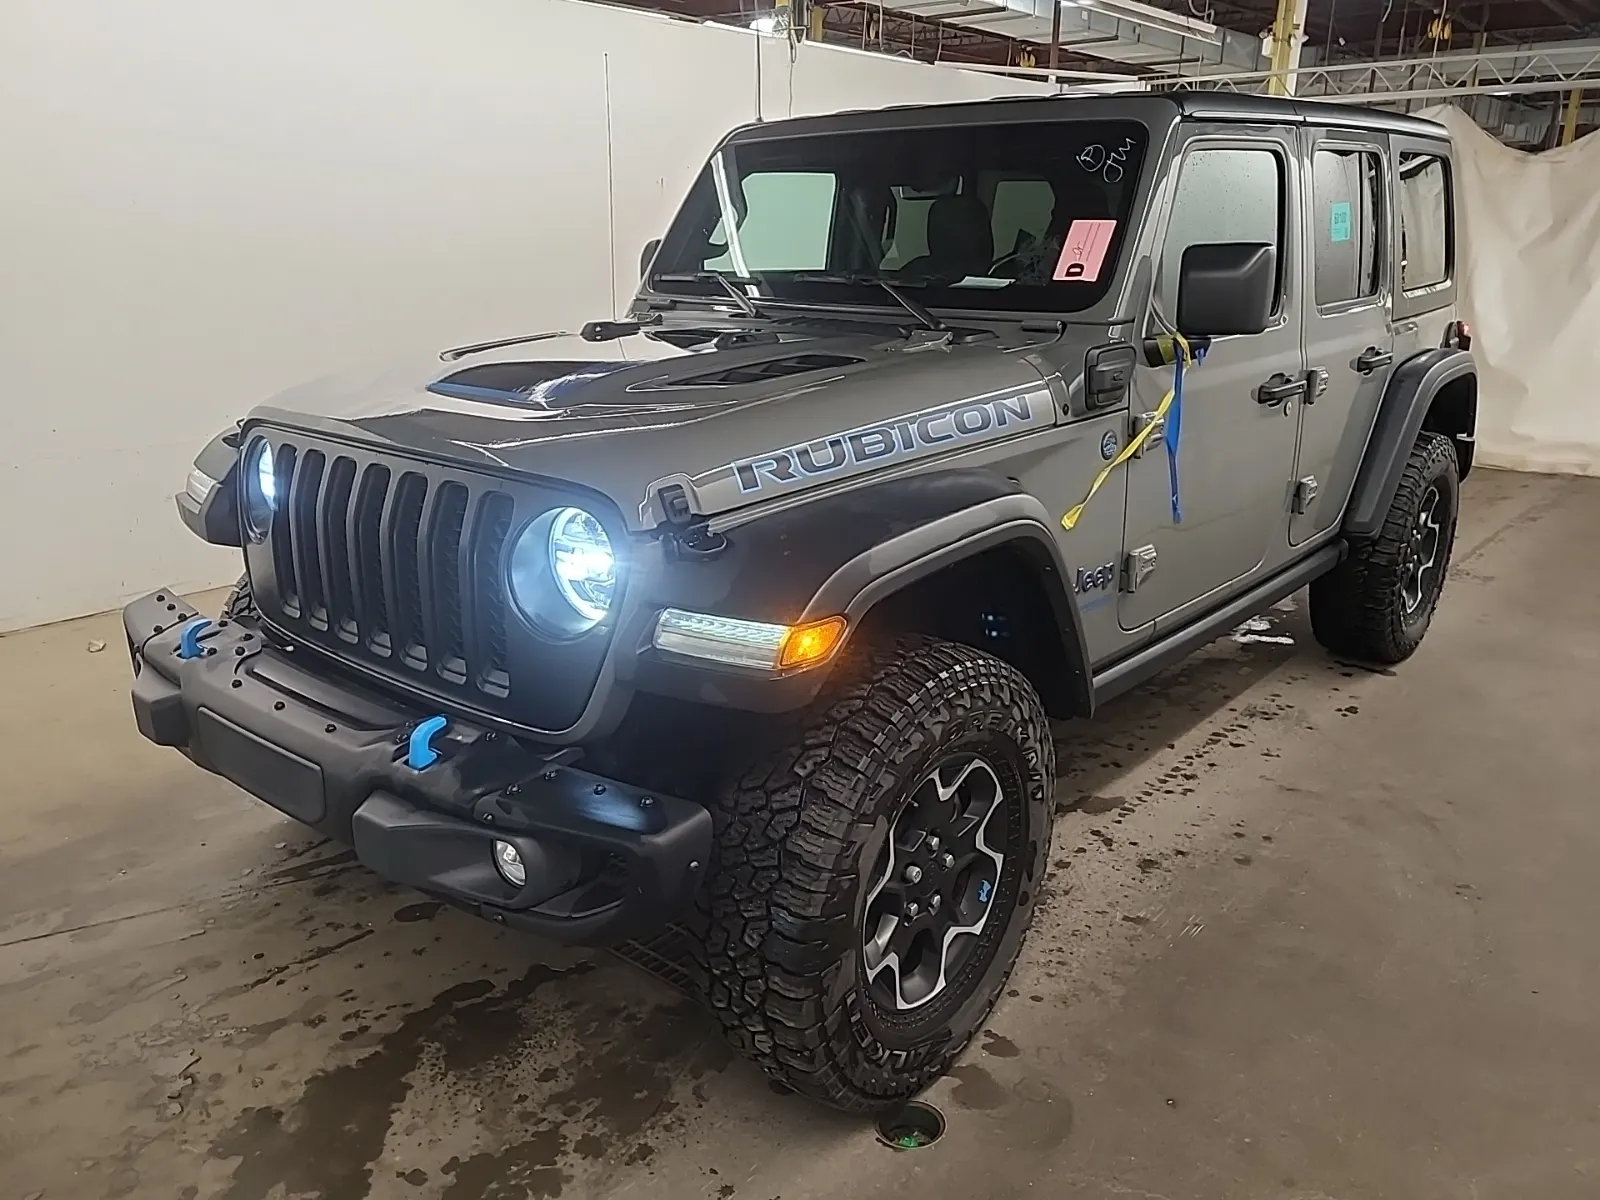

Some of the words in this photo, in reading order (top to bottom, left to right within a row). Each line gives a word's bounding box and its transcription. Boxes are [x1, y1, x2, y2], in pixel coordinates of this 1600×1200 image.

[1064, 262, 1085, 278] D
[731, 393, 1034, 493] RUBICON
[1072, 562, 1115, 594] Jeep
